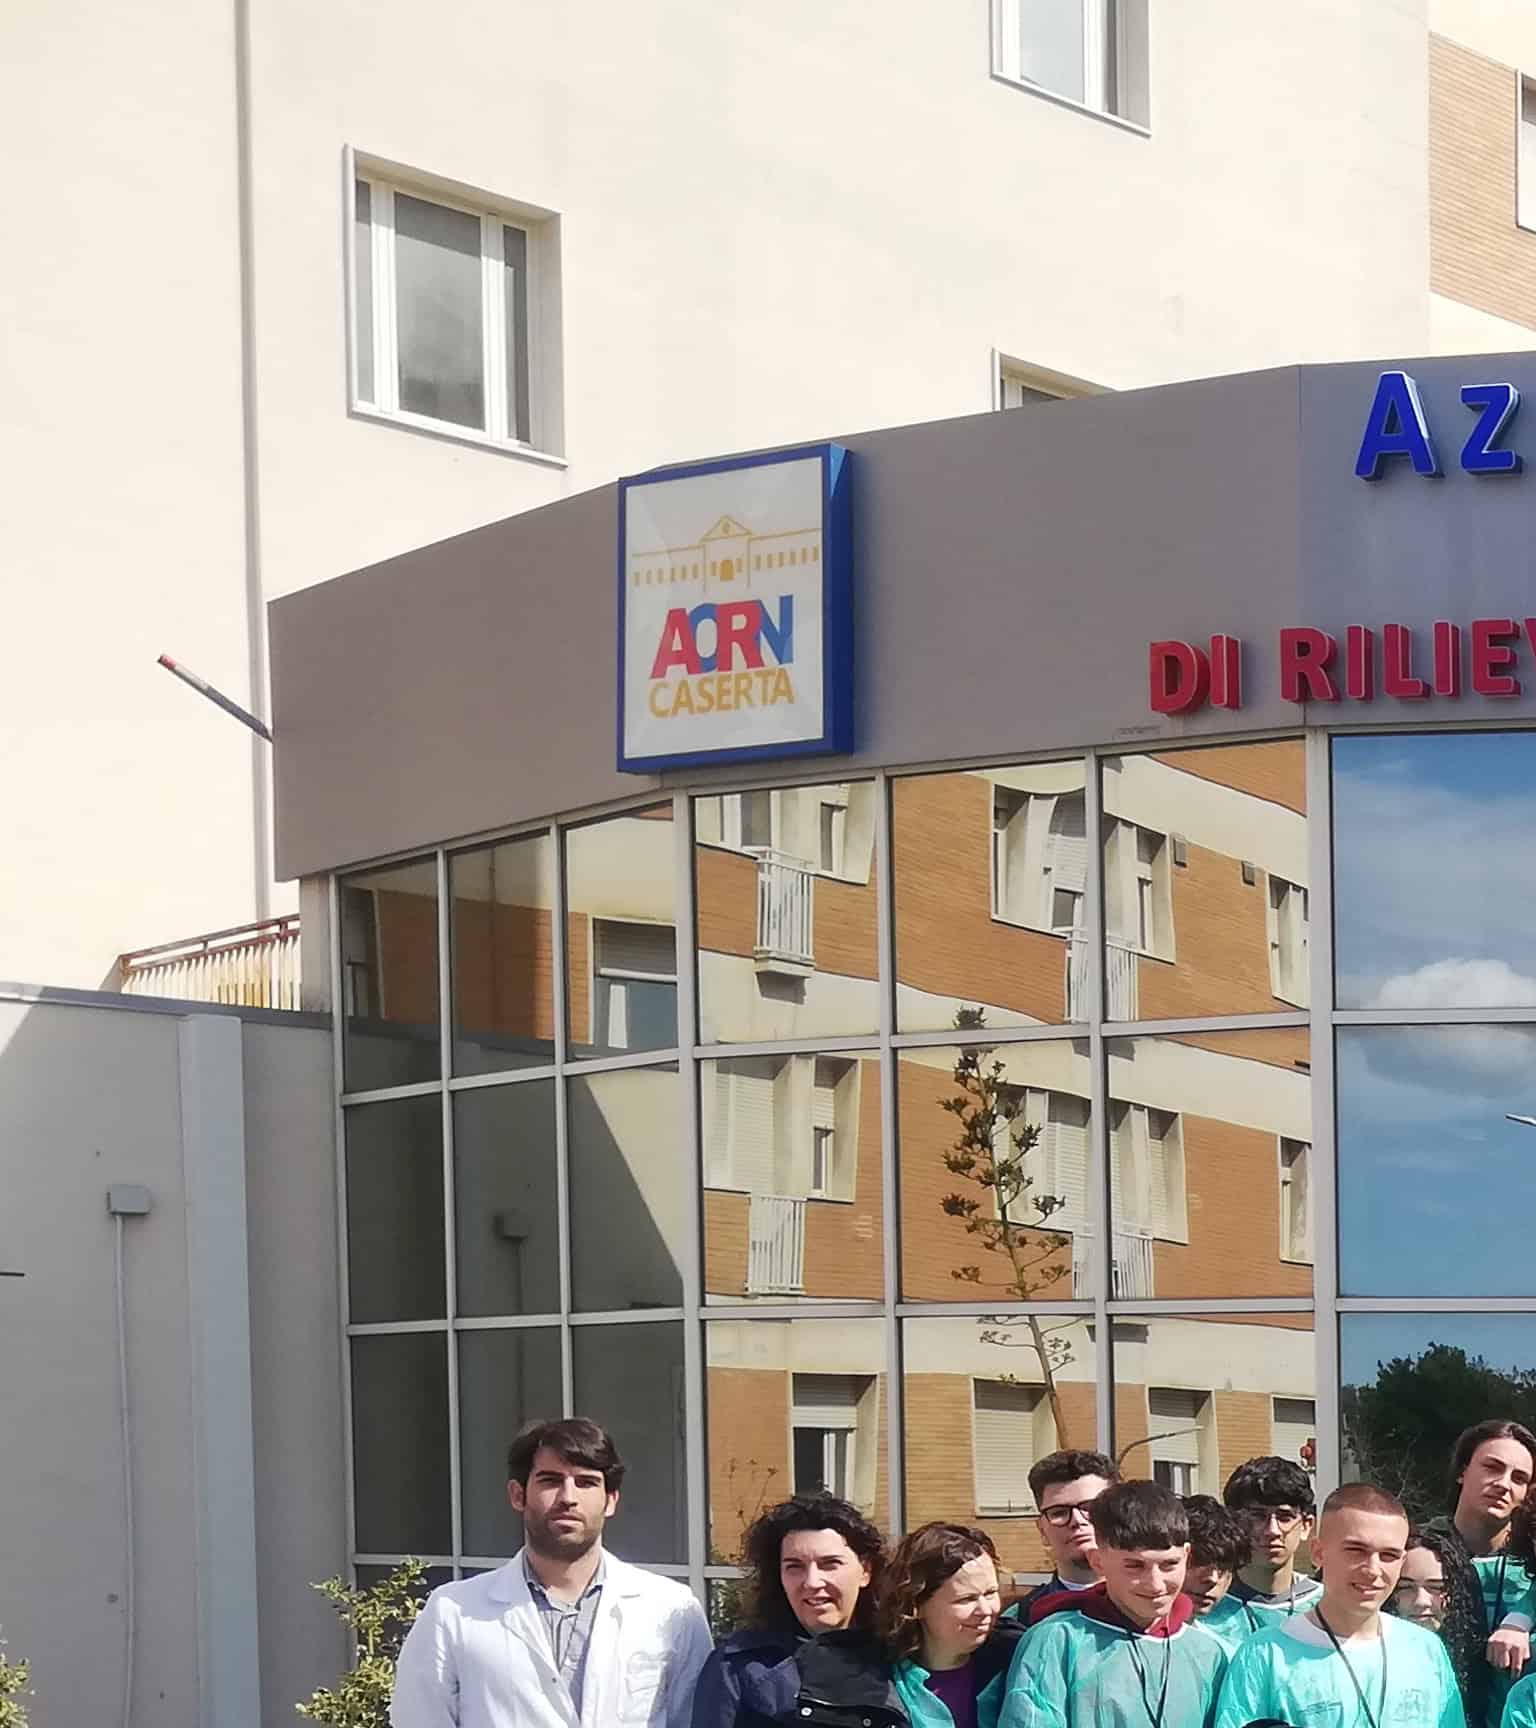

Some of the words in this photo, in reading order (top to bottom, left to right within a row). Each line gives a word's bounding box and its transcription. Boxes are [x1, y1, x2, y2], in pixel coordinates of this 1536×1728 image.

[651, 594, 794, 679] AORN
[649, 667, 795, 718] CASERTA
[1150, 638, 1243, 718] DI
